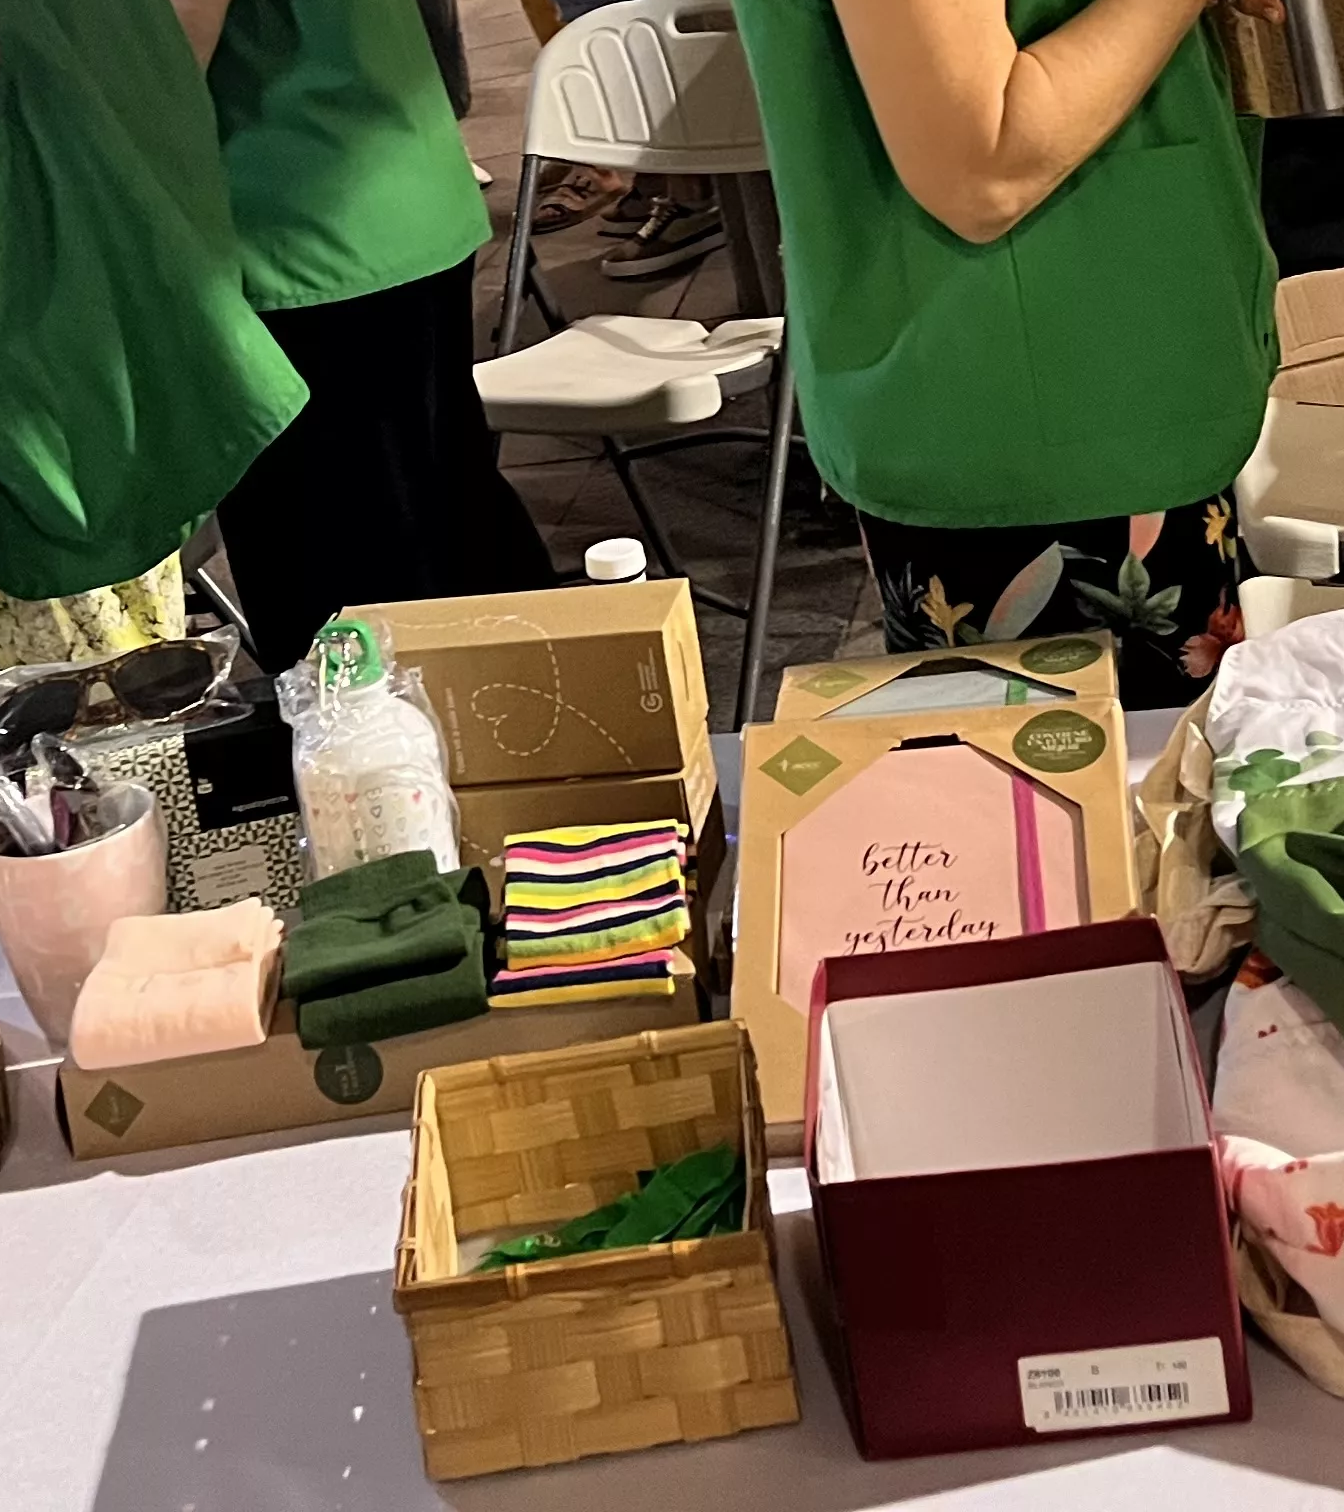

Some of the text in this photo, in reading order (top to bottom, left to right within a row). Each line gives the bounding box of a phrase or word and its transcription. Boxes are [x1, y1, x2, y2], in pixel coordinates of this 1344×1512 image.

[862, 841, 958, 876] better
[868, 875, 961, 912] than
[840, 909, 1000, 956] yesterday
